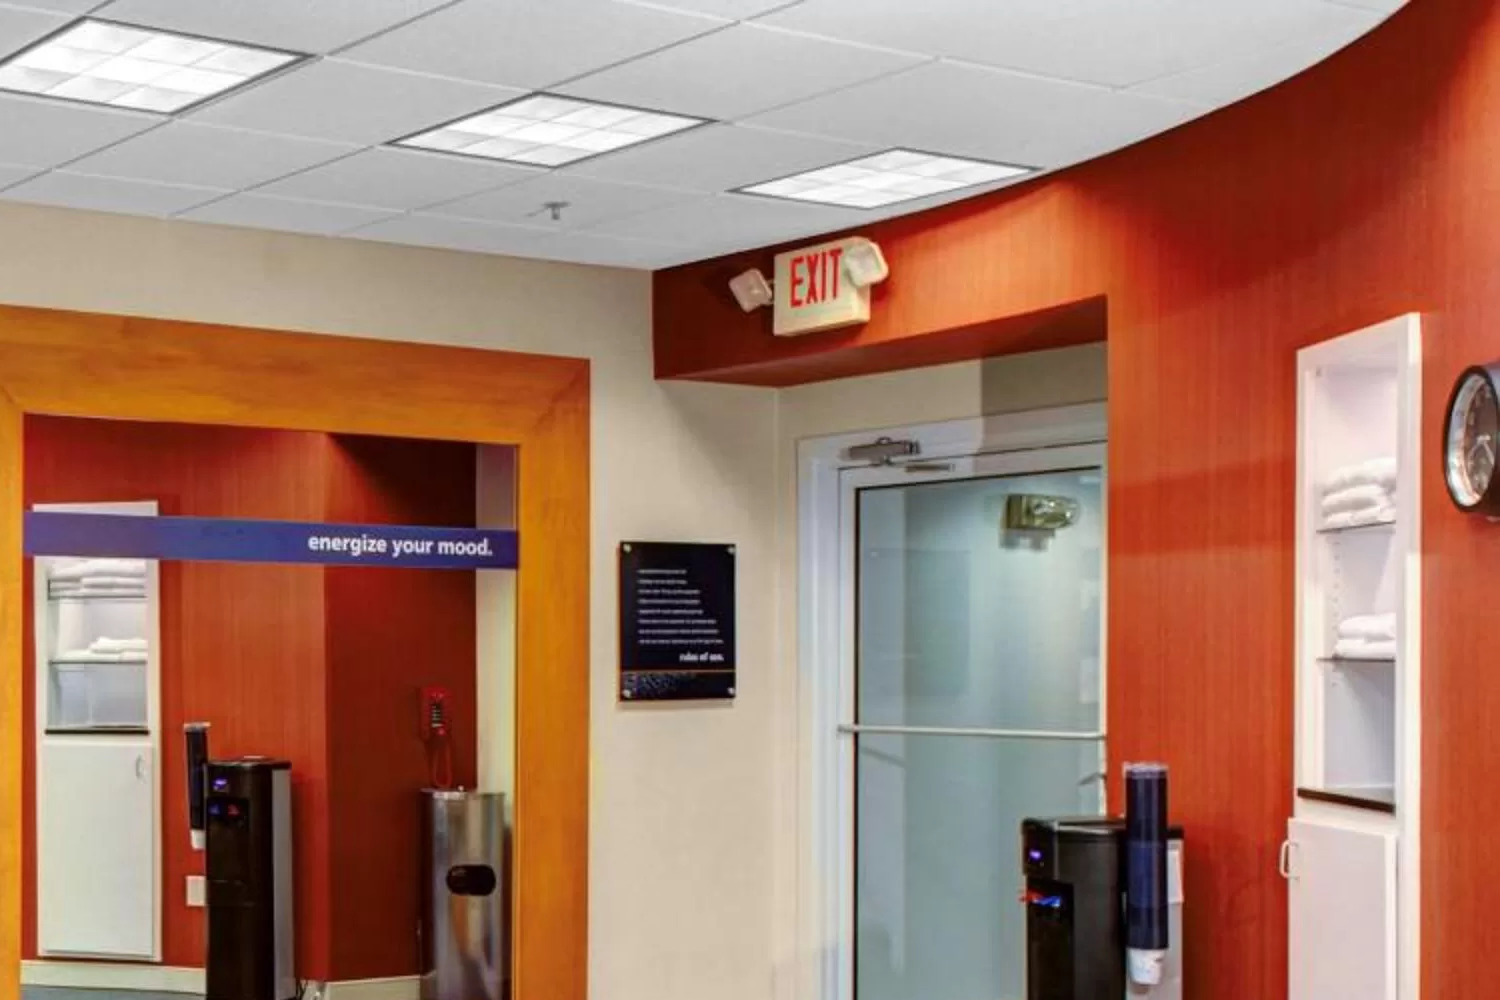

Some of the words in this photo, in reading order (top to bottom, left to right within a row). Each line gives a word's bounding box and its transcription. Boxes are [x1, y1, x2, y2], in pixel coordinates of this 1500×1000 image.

[789, 247, 843, 308] EXIT
[307, 533, 388, 557] energize
[391, 538, 434, 558] your
[437, 538, 493, 556] mood.
